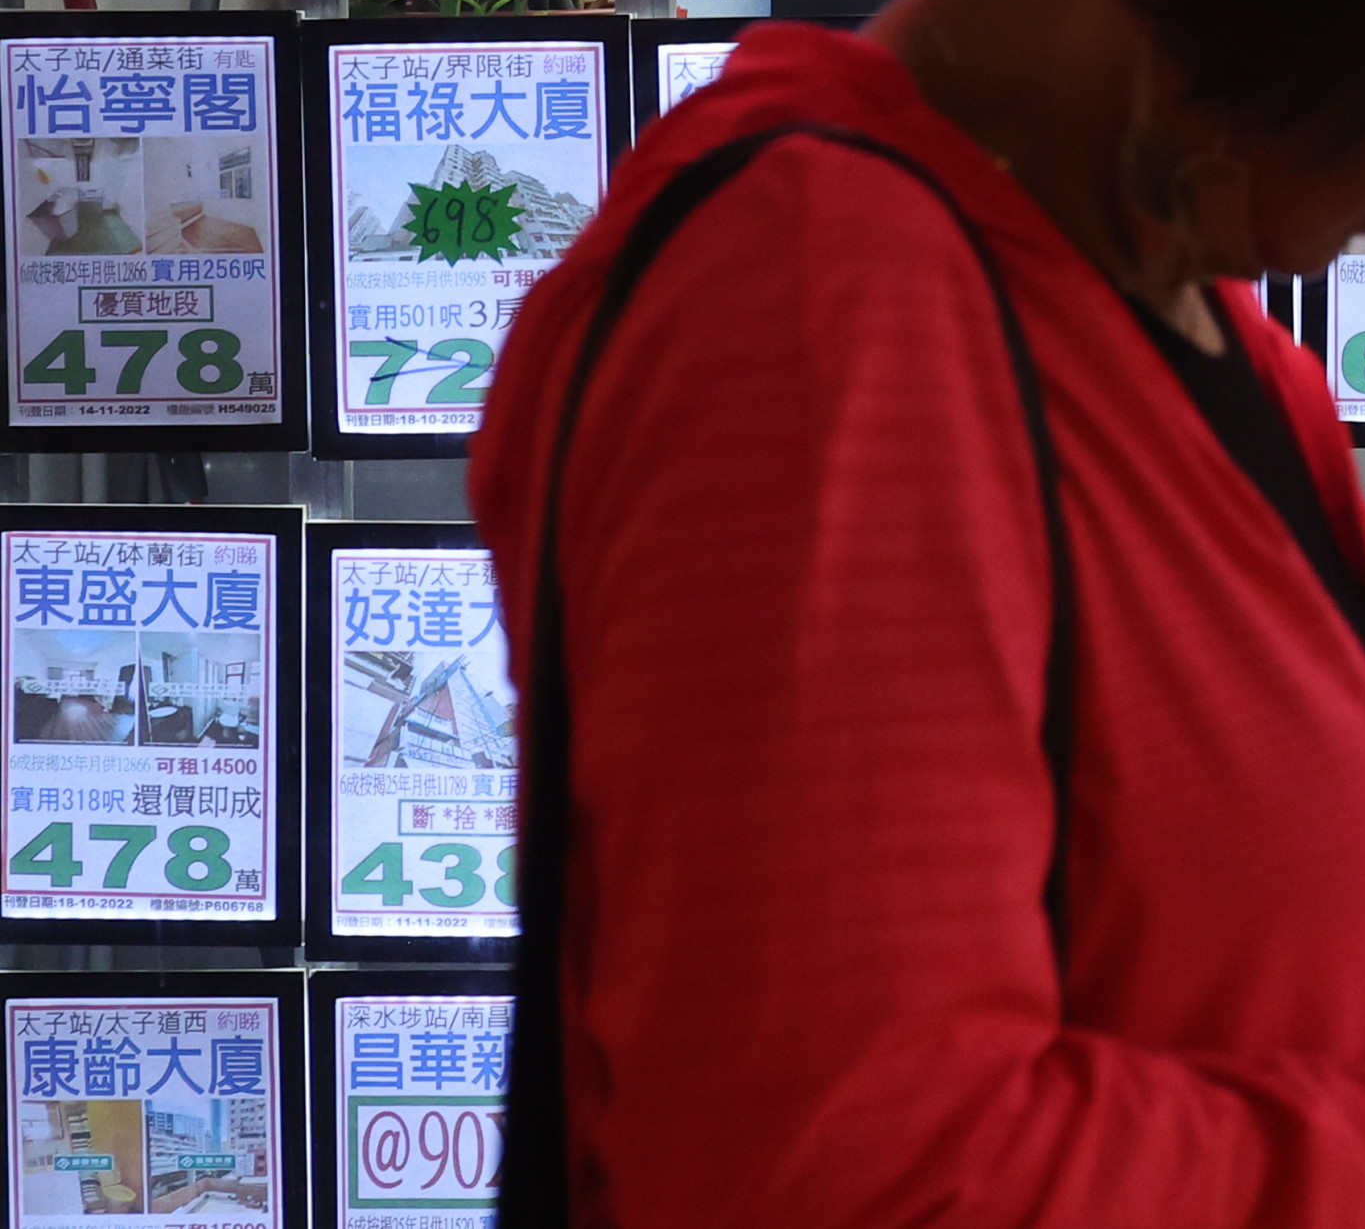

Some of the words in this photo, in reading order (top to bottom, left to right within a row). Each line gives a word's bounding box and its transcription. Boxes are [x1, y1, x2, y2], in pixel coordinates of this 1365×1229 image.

[15, 47, 204, 72] 太子站/通菜街
[343, 55, 533, 79] 太子站/界限街
[17, 73, 257, 133] 怡寧閣
[343, 79, 592, 142] 福祿大廈
[94, 291, 199, 316] 優質地段
[15, 568, 261, 630] 東盛大廈
[132, 785, 262, 818] 還價即成
[17, 1011, 206, 1036] 太子站/太子道西
[22, 1037, 266, 1096] 康齡大廈
